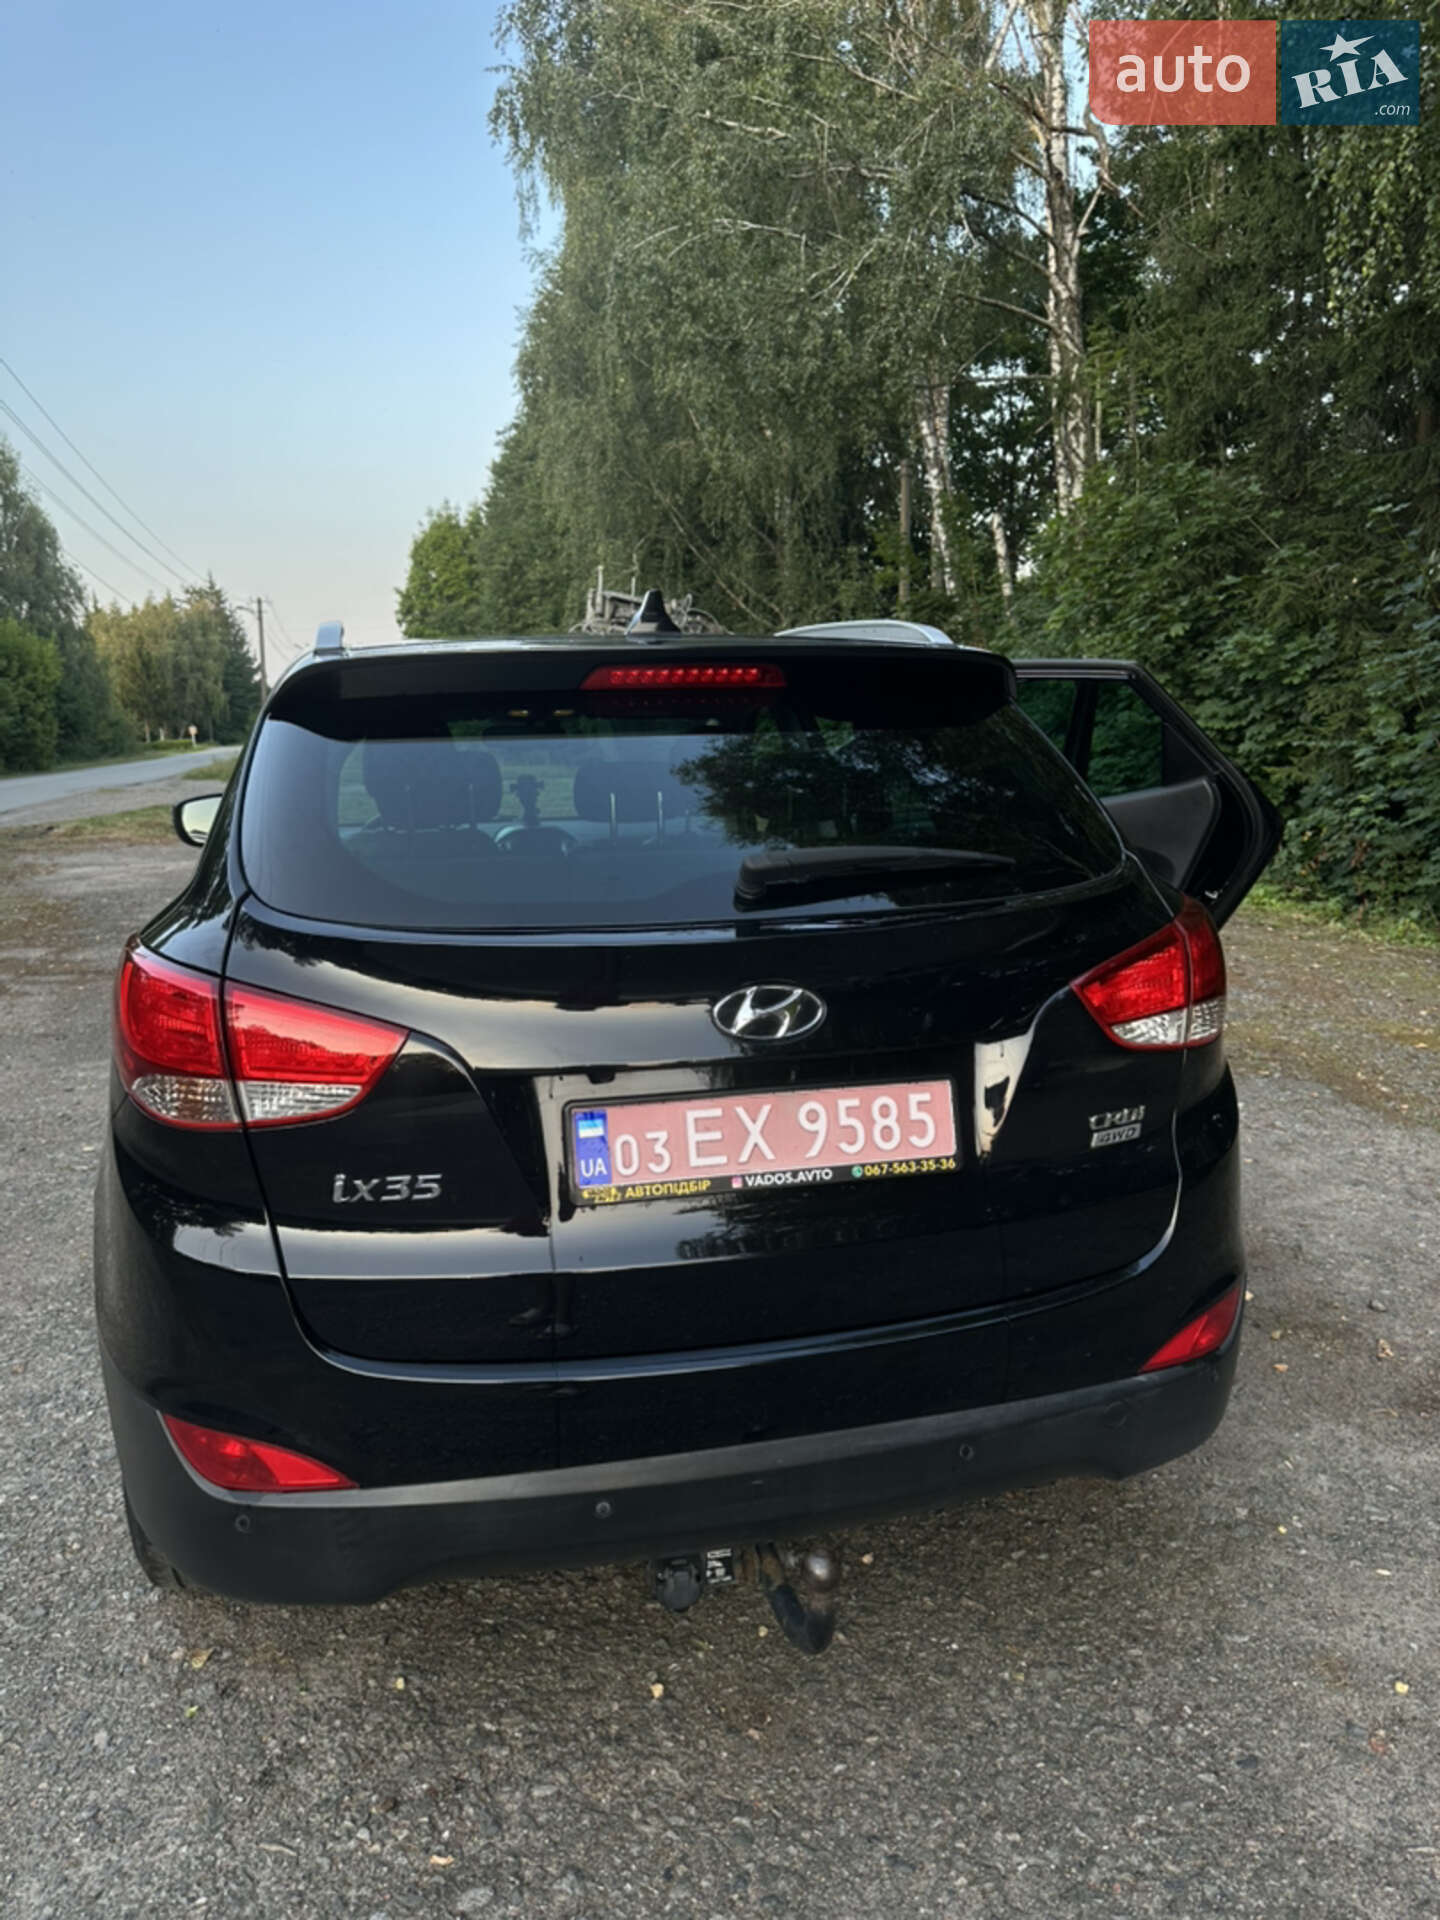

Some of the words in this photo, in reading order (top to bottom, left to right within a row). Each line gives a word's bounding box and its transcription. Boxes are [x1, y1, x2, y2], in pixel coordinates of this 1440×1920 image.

[614, 1130, 672, 1176] 03
[798, 1092, 936, 1159] 9585
[580, 1158, 608, 1177] UA
[864, 1157, 956, 1177] 067-563-35-36
[745, 1168, 833, 1187] VADOS.AVTO
[333, 1173, 442, 1203] ix35
[625, 1180, 712, 1199] АВТОПІДБІР
